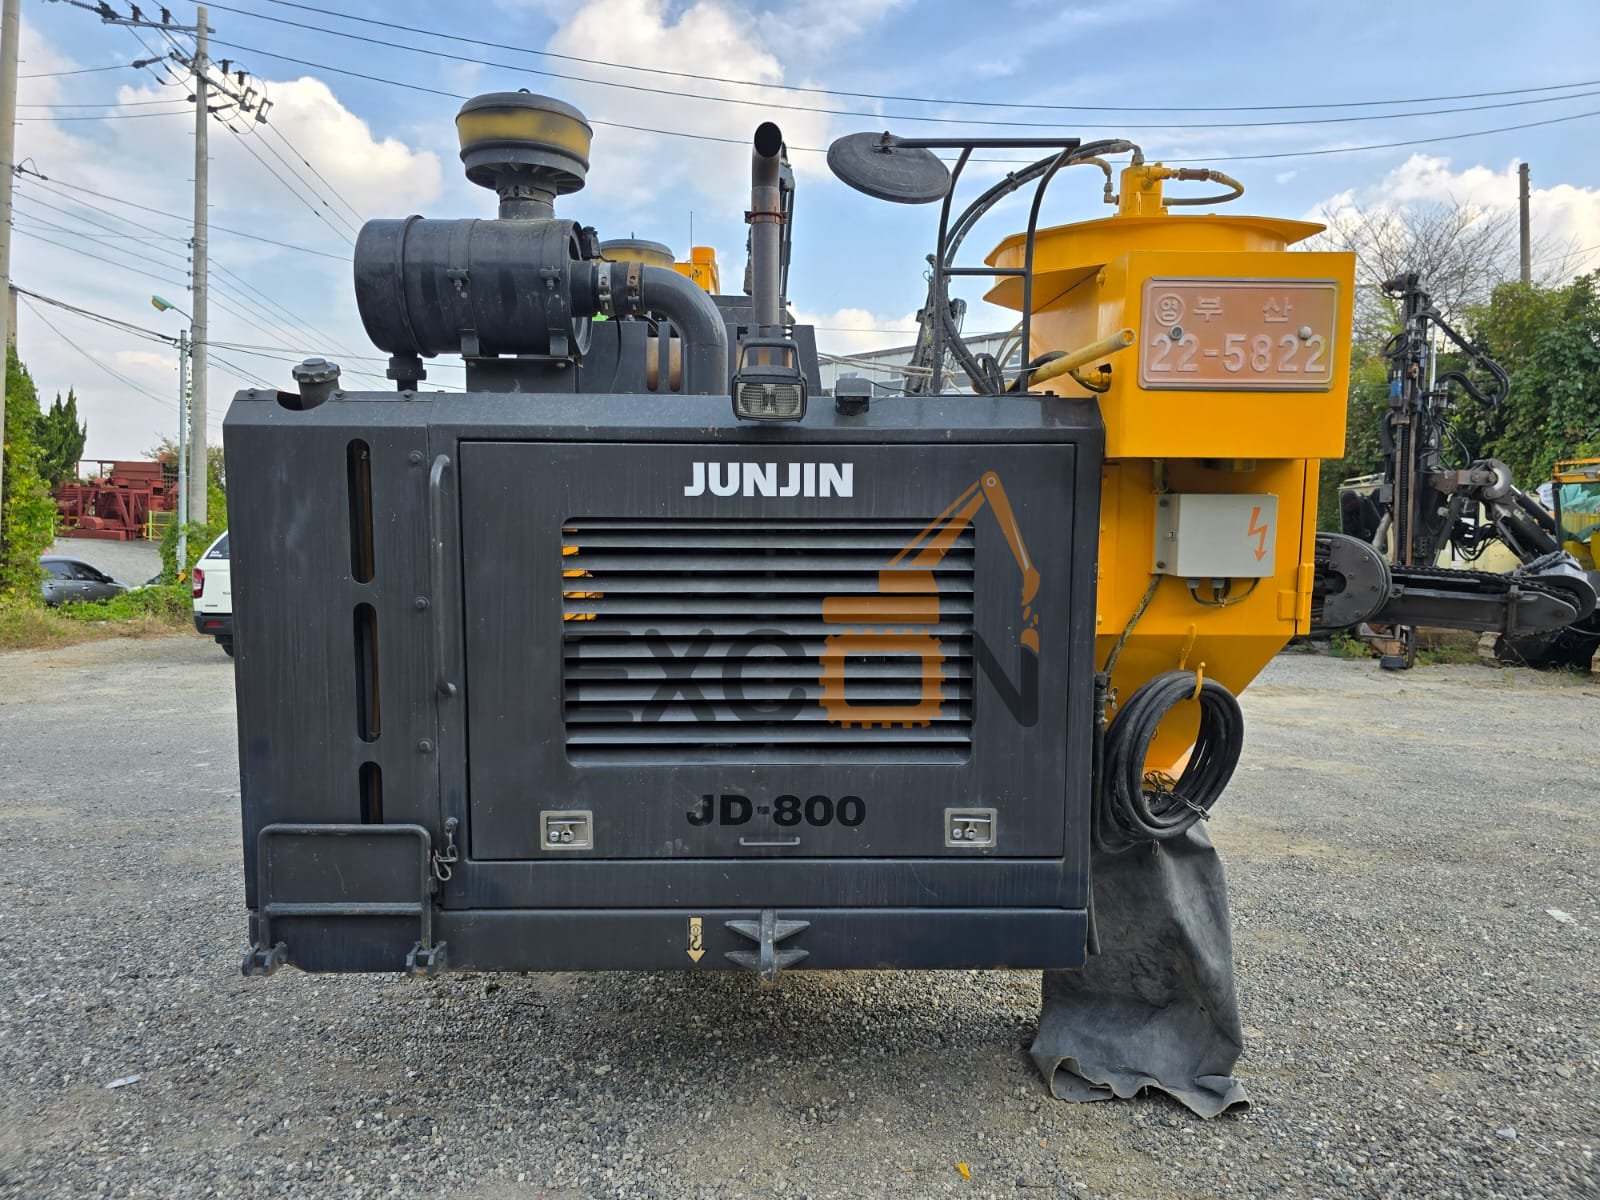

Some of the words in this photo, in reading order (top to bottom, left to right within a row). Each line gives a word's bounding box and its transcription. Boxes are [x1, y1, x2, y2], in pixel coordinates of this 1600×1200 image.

[1150, 333, 1326, 373] 22-5822
[684, 462, 854, 497] JUNJIN
[686, 794, 867, 827] JD-800
